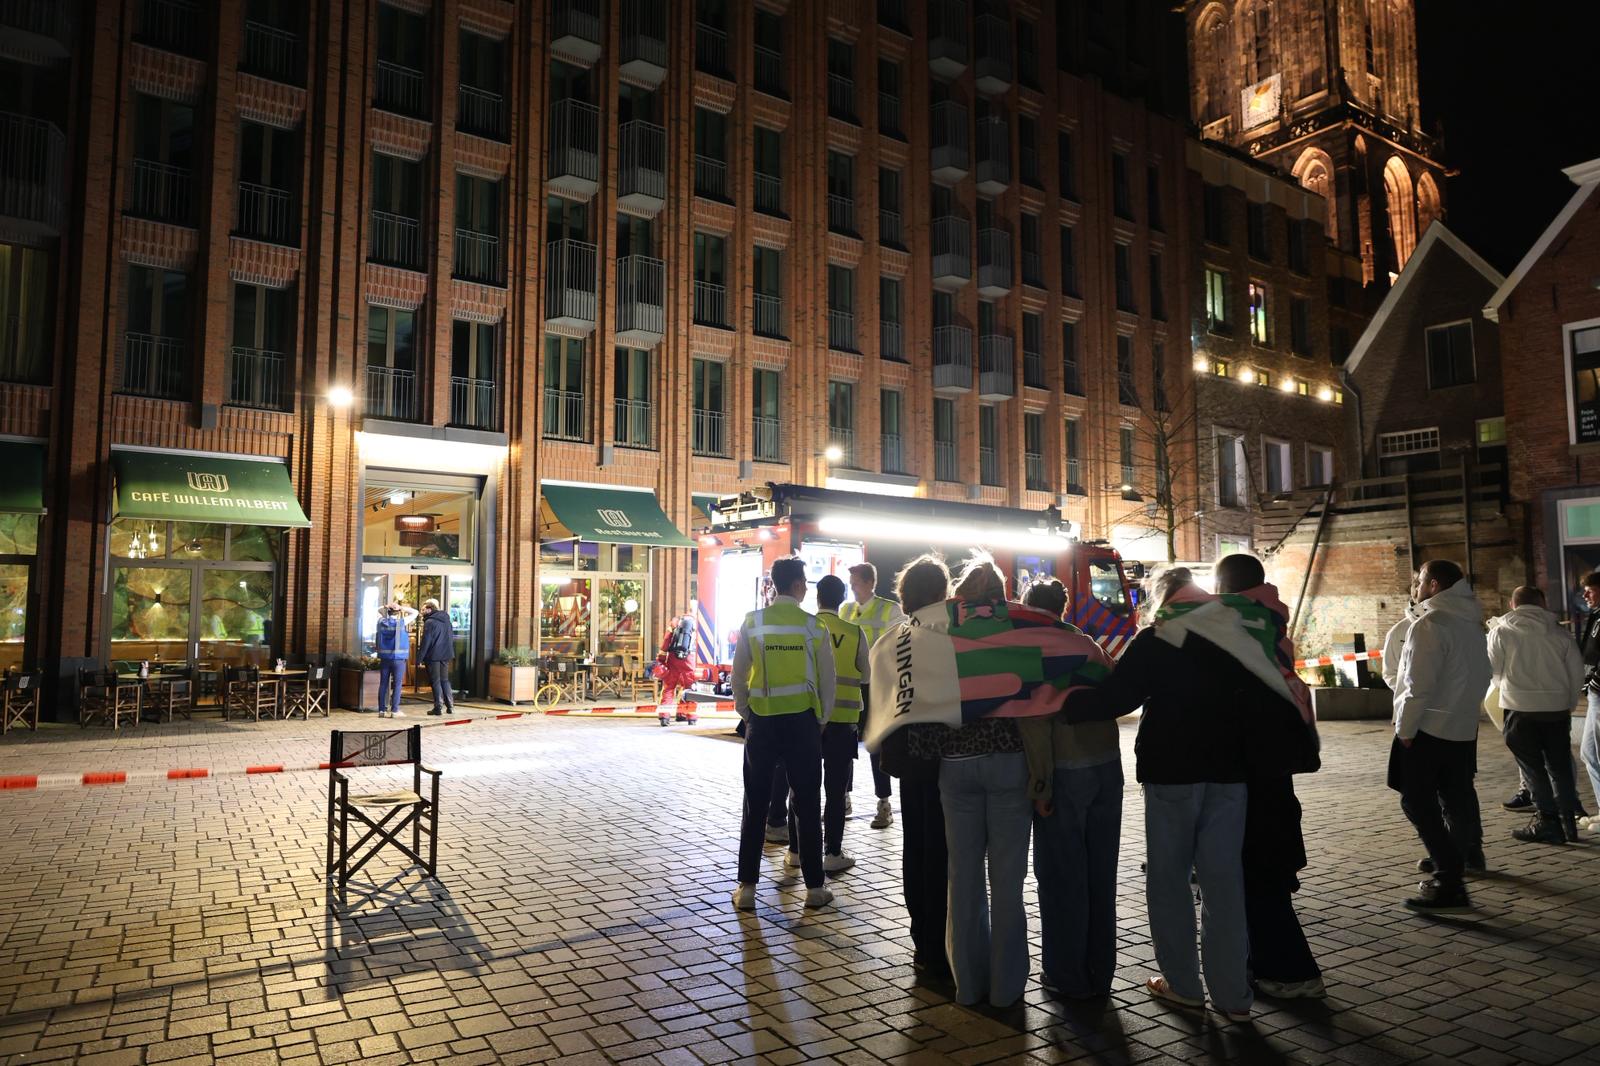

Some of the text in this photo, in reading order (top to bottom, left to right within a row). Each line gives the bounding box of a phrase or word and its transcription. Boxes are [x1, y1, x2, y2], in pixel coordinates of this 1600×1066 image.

[174, 494, 233, 507] WILLEM
[236, 499, 288, 510] ALBERT
[765, 643, 804, 651] ONTRUIMER
[832, 633, 845, 648] V
